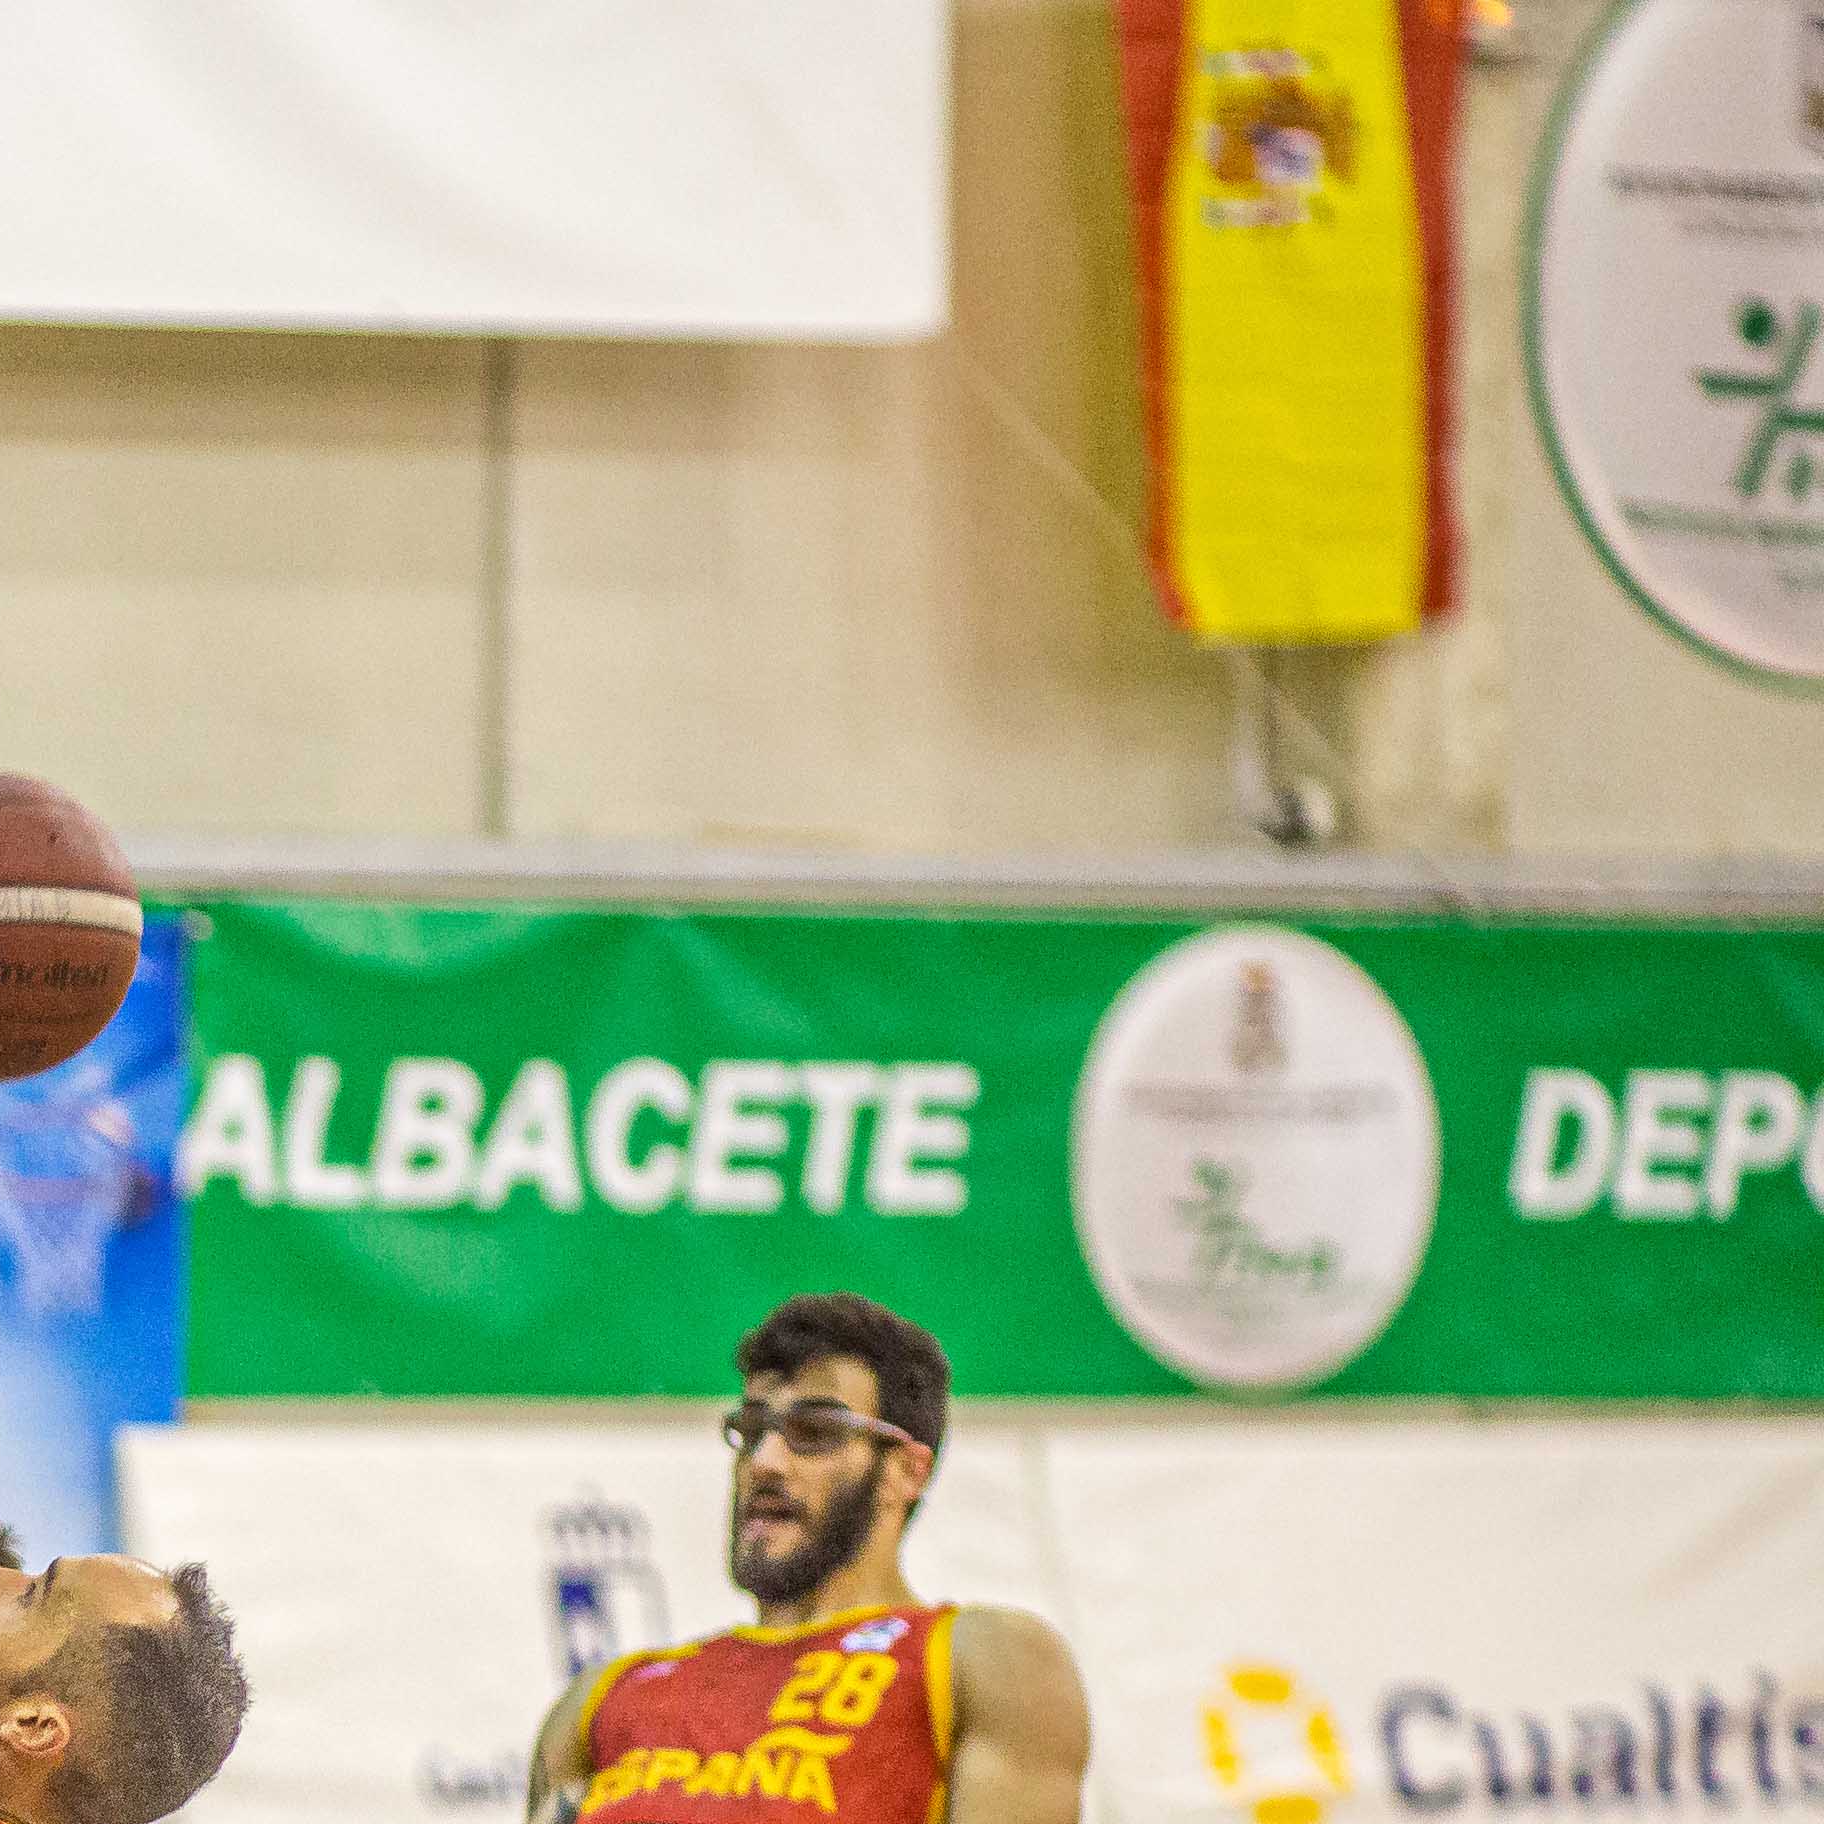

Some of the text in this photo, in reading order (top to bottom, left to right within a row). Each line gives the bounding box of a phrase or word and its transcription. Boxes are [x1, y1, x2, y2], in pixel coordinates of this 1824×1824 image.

[180, 1056, 980, 1216] ALBACETE
[1508, 1066, 1824, 1222] DEP
[768, 1650, 900, 1726] 28
